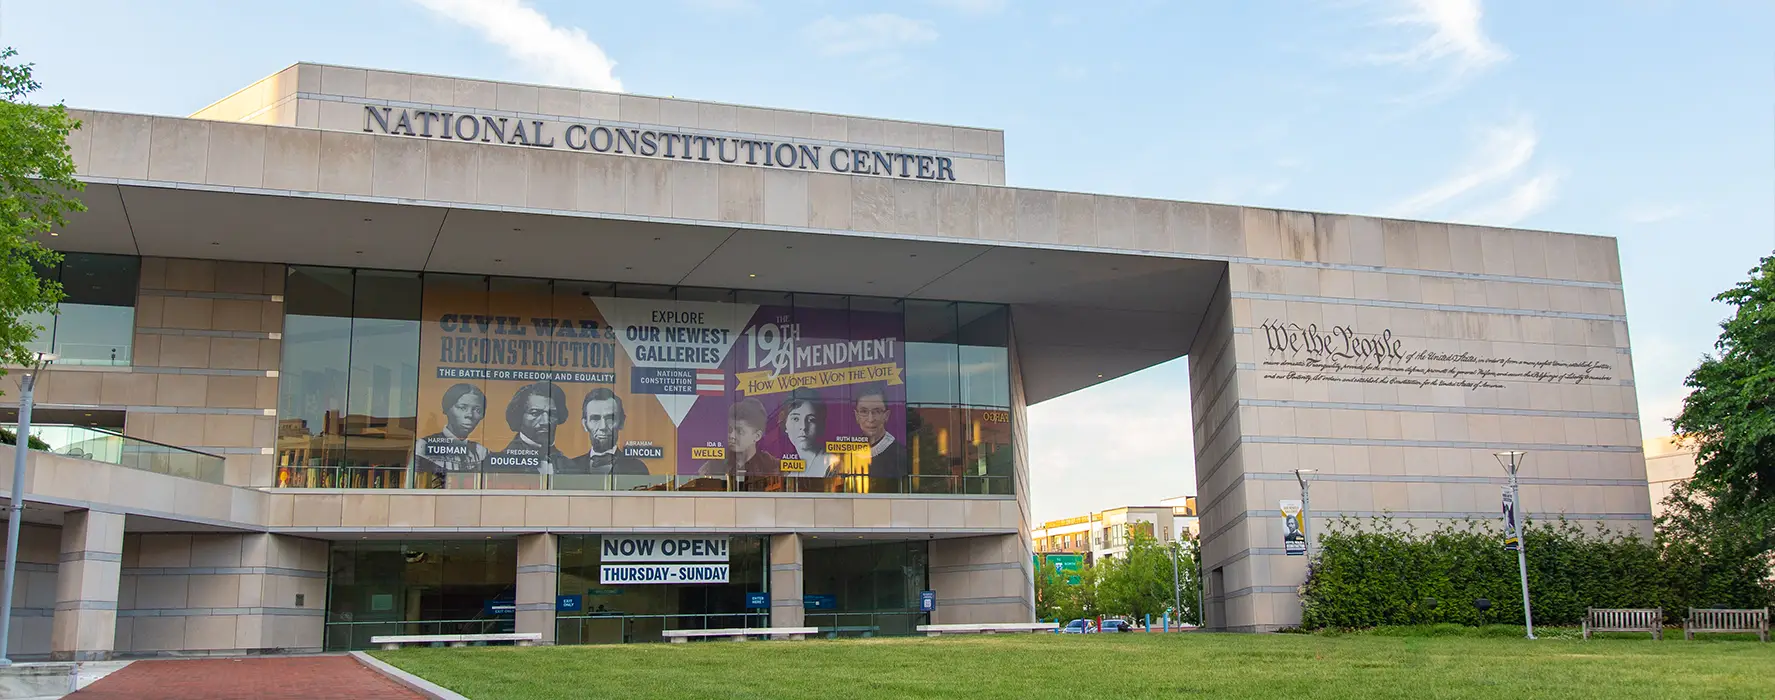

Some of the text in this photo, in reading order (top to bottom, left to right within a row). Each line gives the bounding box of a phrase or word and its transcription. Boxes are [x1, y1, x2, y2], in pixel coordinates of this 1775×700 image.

[363, 105, 956, 181] NATIONAL CONSTITUTION CENTER
[651, 310, 705, 325] EXPLORE
[776, 315, 790, 323] THE
[440, 313, 616, 340] CIVIL WAR &
[626, 325, 730, 345] OUR NEWEST
[1260, 318, 1303, 358] We
[1331, 325, 1407, 370] People
[440, 336, 615, 369] RECONSTRUCTION
[635, 345, 720, 364] GALLERIES
[439, 368, 615, 382] THE BATTLE FOR FREEDOM AND EQUALITY
[656, 370, 692, 378] NATIONAL
[848, 368, 866, 380] THE
[640, 377, 692, 385] CONSTITUTION
[428, 445, 467, 455] TUBMAN
[624, 448, 661, 457] LINCOLN
[827, 443, 868, 452] GINSBURG
[694, 450, 724, 458] WELLS
[490, 457, 539, 466] DOUGLASS
[782, 462, 804, 470] PAUL
[603, 538, 727, 556] NOW OPEN!
